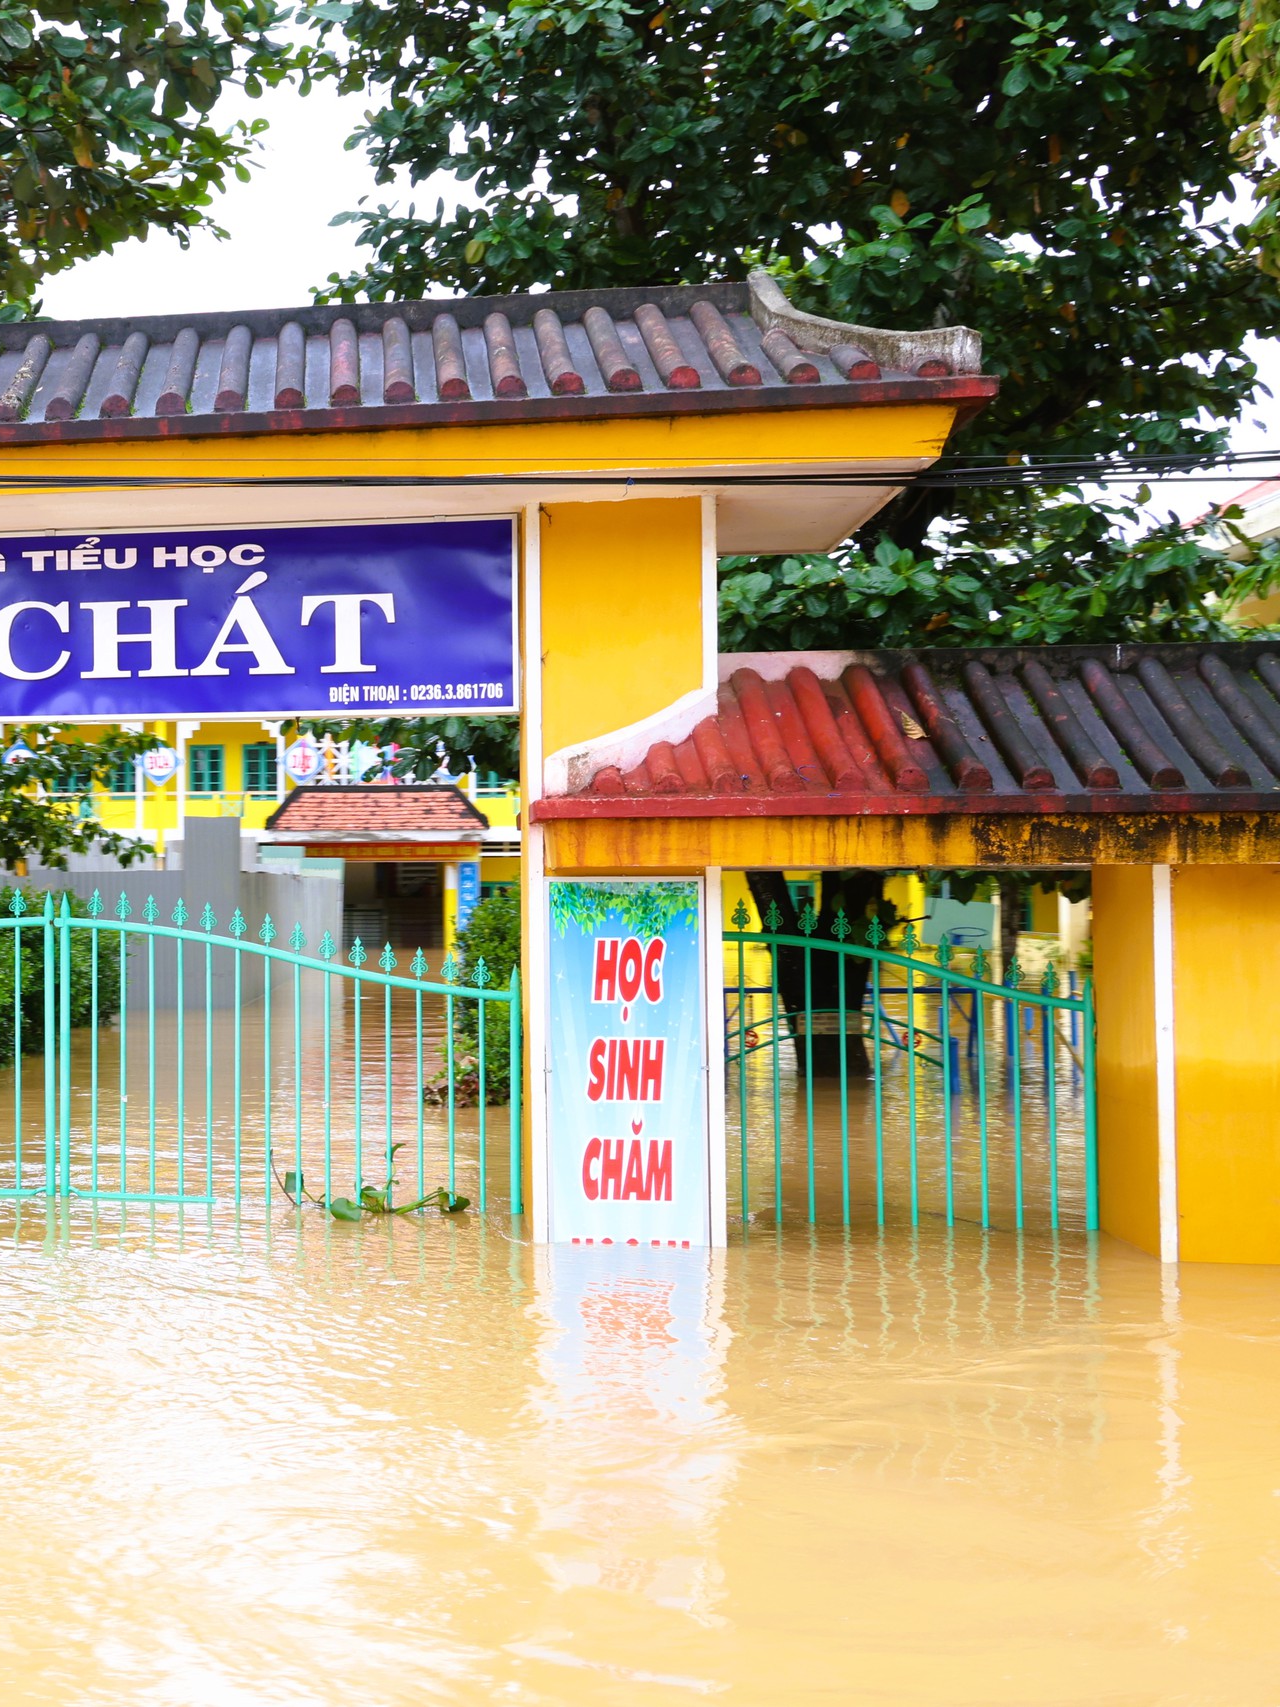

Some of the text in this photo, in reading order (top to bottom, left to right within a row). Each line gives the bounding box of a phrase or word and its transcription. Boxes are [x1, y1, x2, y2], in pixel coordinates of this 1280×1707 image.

[21, 536, 138, 572] TIỂU
[153, 544, 266, 574] HỌC
[329, 683, 360, 705] ĐIỆN
[363, 685, 400, 704] THOẠI
[410, 683, 504, 701] 0236.3.861706
[593, 937, 665, 1022] HỌC
[586, 1037, 666, 1102] SINH
[581, 1117, 674, 1203] CHĂM
